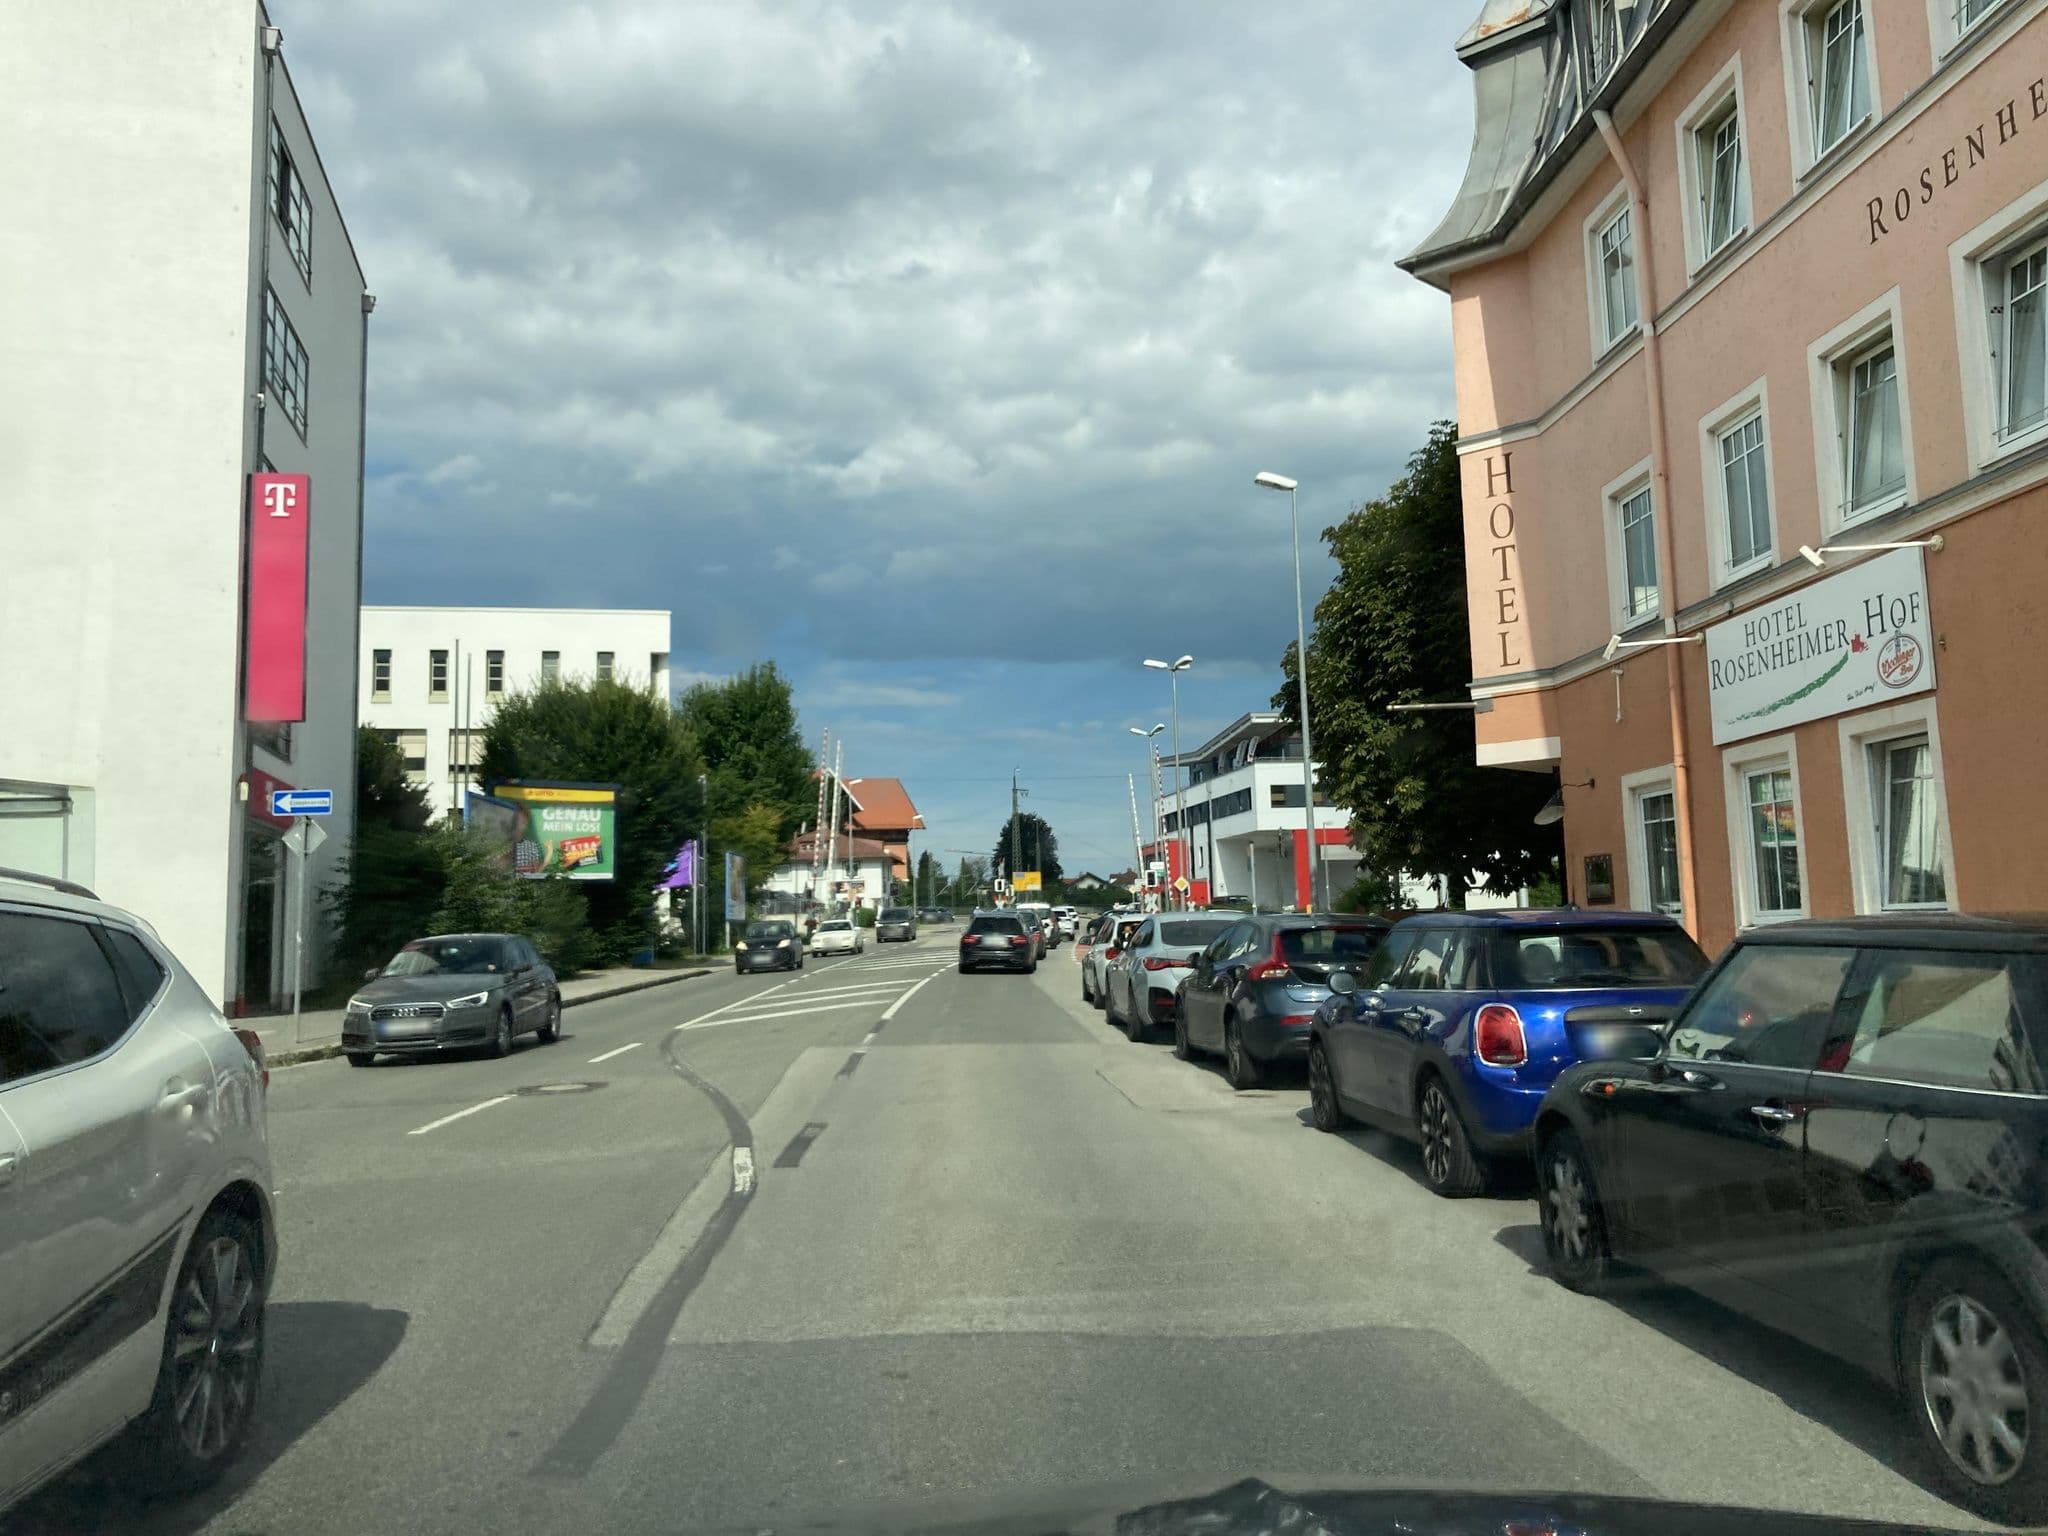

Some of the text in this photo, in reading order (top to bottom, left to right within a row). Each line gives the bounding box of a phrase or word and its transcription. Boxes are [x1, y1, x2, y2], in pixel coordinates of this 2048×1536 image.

[265, 483, 296, 517] T
[1484, 452, 1521, 668] HOTEL
[1710, 591, 1921, 690] ROSENHEIMER HOF
[1744, 602, 1807, 648] HOTEL
[541, 806, 601, 822] GENAU
[542, 821, 573, 833] MEIN
